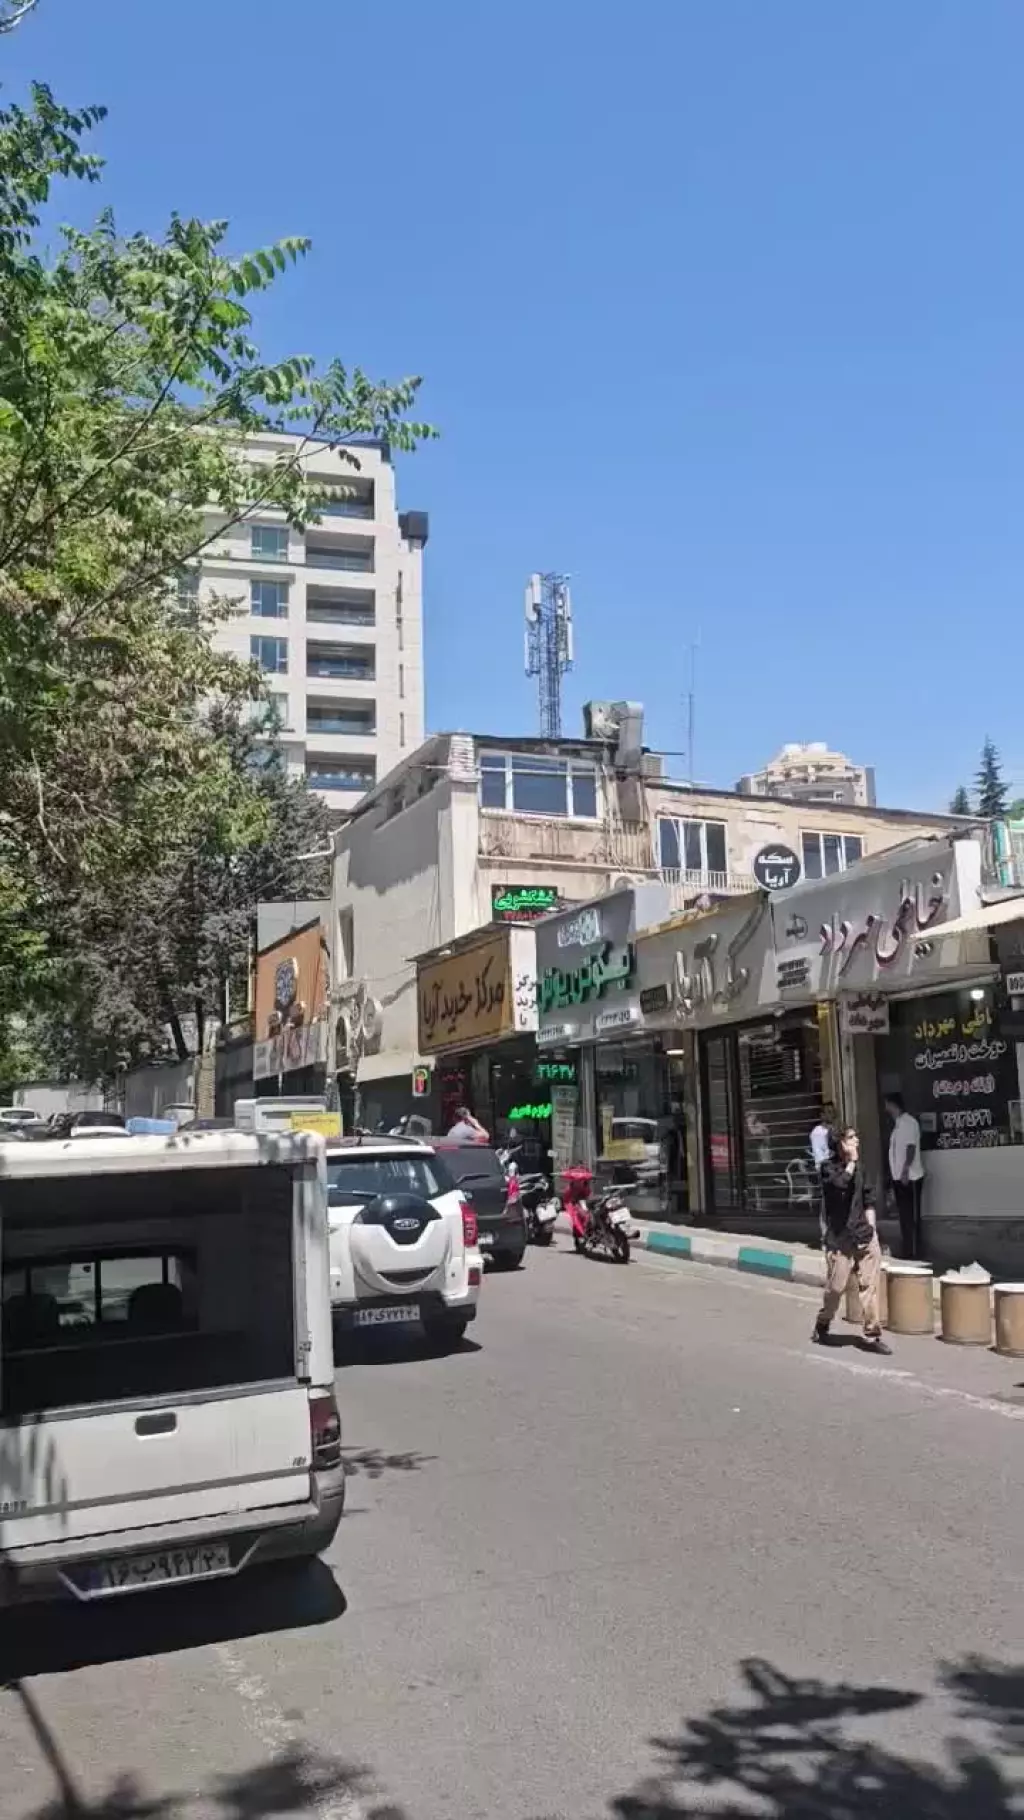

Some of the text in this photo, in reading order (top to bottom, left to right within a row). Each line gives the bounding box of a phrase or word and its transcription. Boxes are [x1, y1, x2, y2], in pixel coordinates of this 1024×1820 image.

[757, 851, 793, 864] سکه
[765, 868, 792, 888] آریا
[819, 911, 884, 978] مهرداد
[914, 1018, 956, 1039] مهرداد
